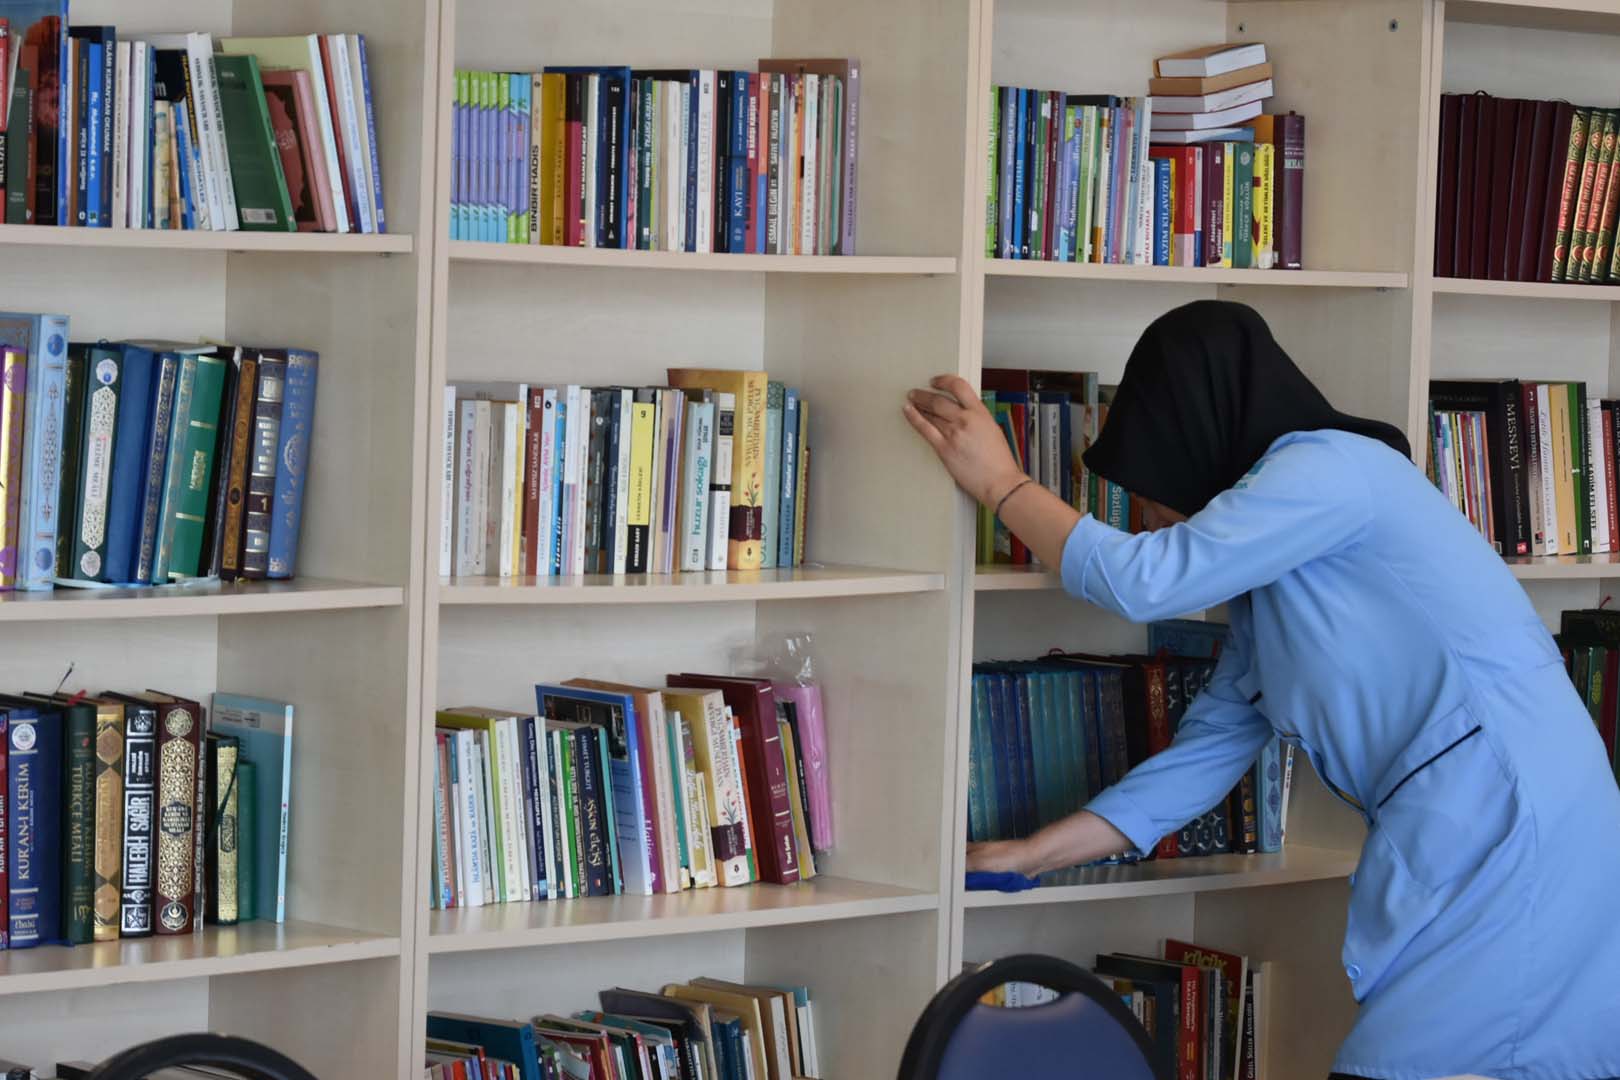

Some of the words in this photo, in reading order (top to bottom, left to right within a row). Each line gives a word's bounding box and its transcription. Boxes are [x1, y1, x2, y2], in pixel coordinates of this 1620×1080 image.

[734, 191, 743, 217] KAYI
[1070, 180, 1079, 226] Muhammed
[1161, 176, 1170, 226] KILAVUZU
[691, 499, 702, 536] huzur
[18, 763, 30, 814] KERİM
[71, 764, 84, 820] TÜRKÇE
